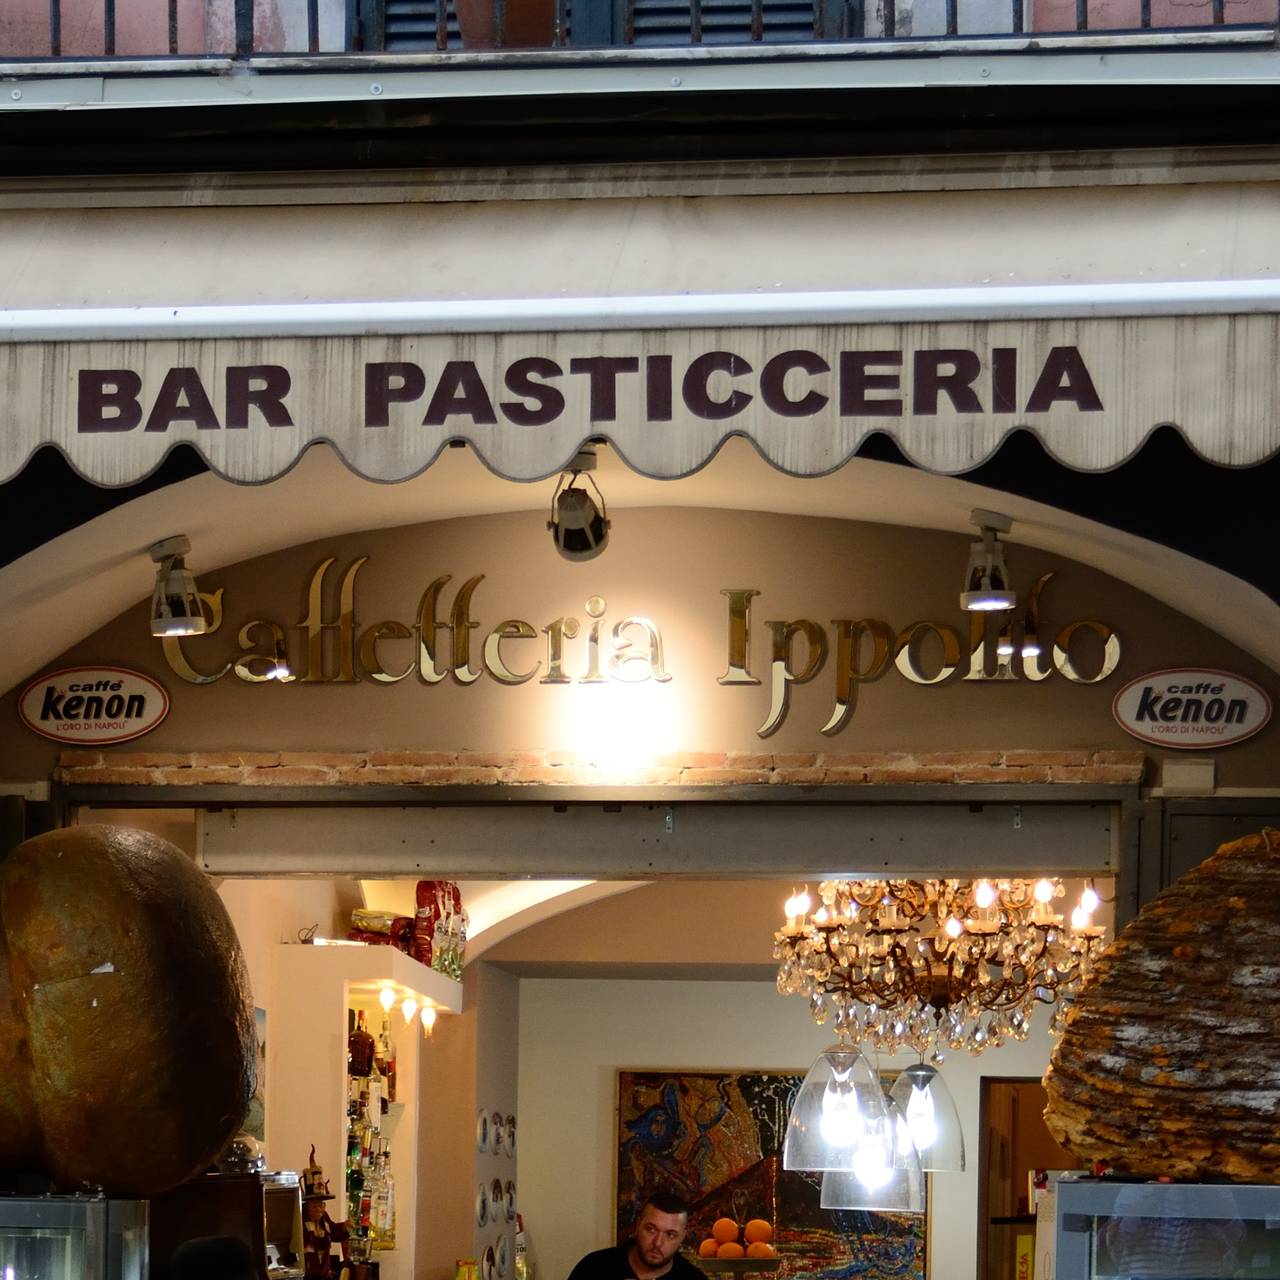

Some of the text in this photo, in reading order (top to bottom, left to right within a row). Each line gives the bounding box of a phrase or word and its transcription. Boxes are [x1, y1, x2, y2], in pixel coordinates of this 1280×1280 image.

[77, 346, 1104, 434] BAR PASTICCERIA
[161, 556, 1120, 739] Caffetteria Ippolito
[40, 687, 145, 721] kenon
[1135, 687, 1248, 724] kenon
[84, 722, 92, 731] DI
[95, 721, 125, 731] NAPOLI
[1181, 726, 1189, 734] DI
[1192, 726, 1223, 735] NAPOLI
